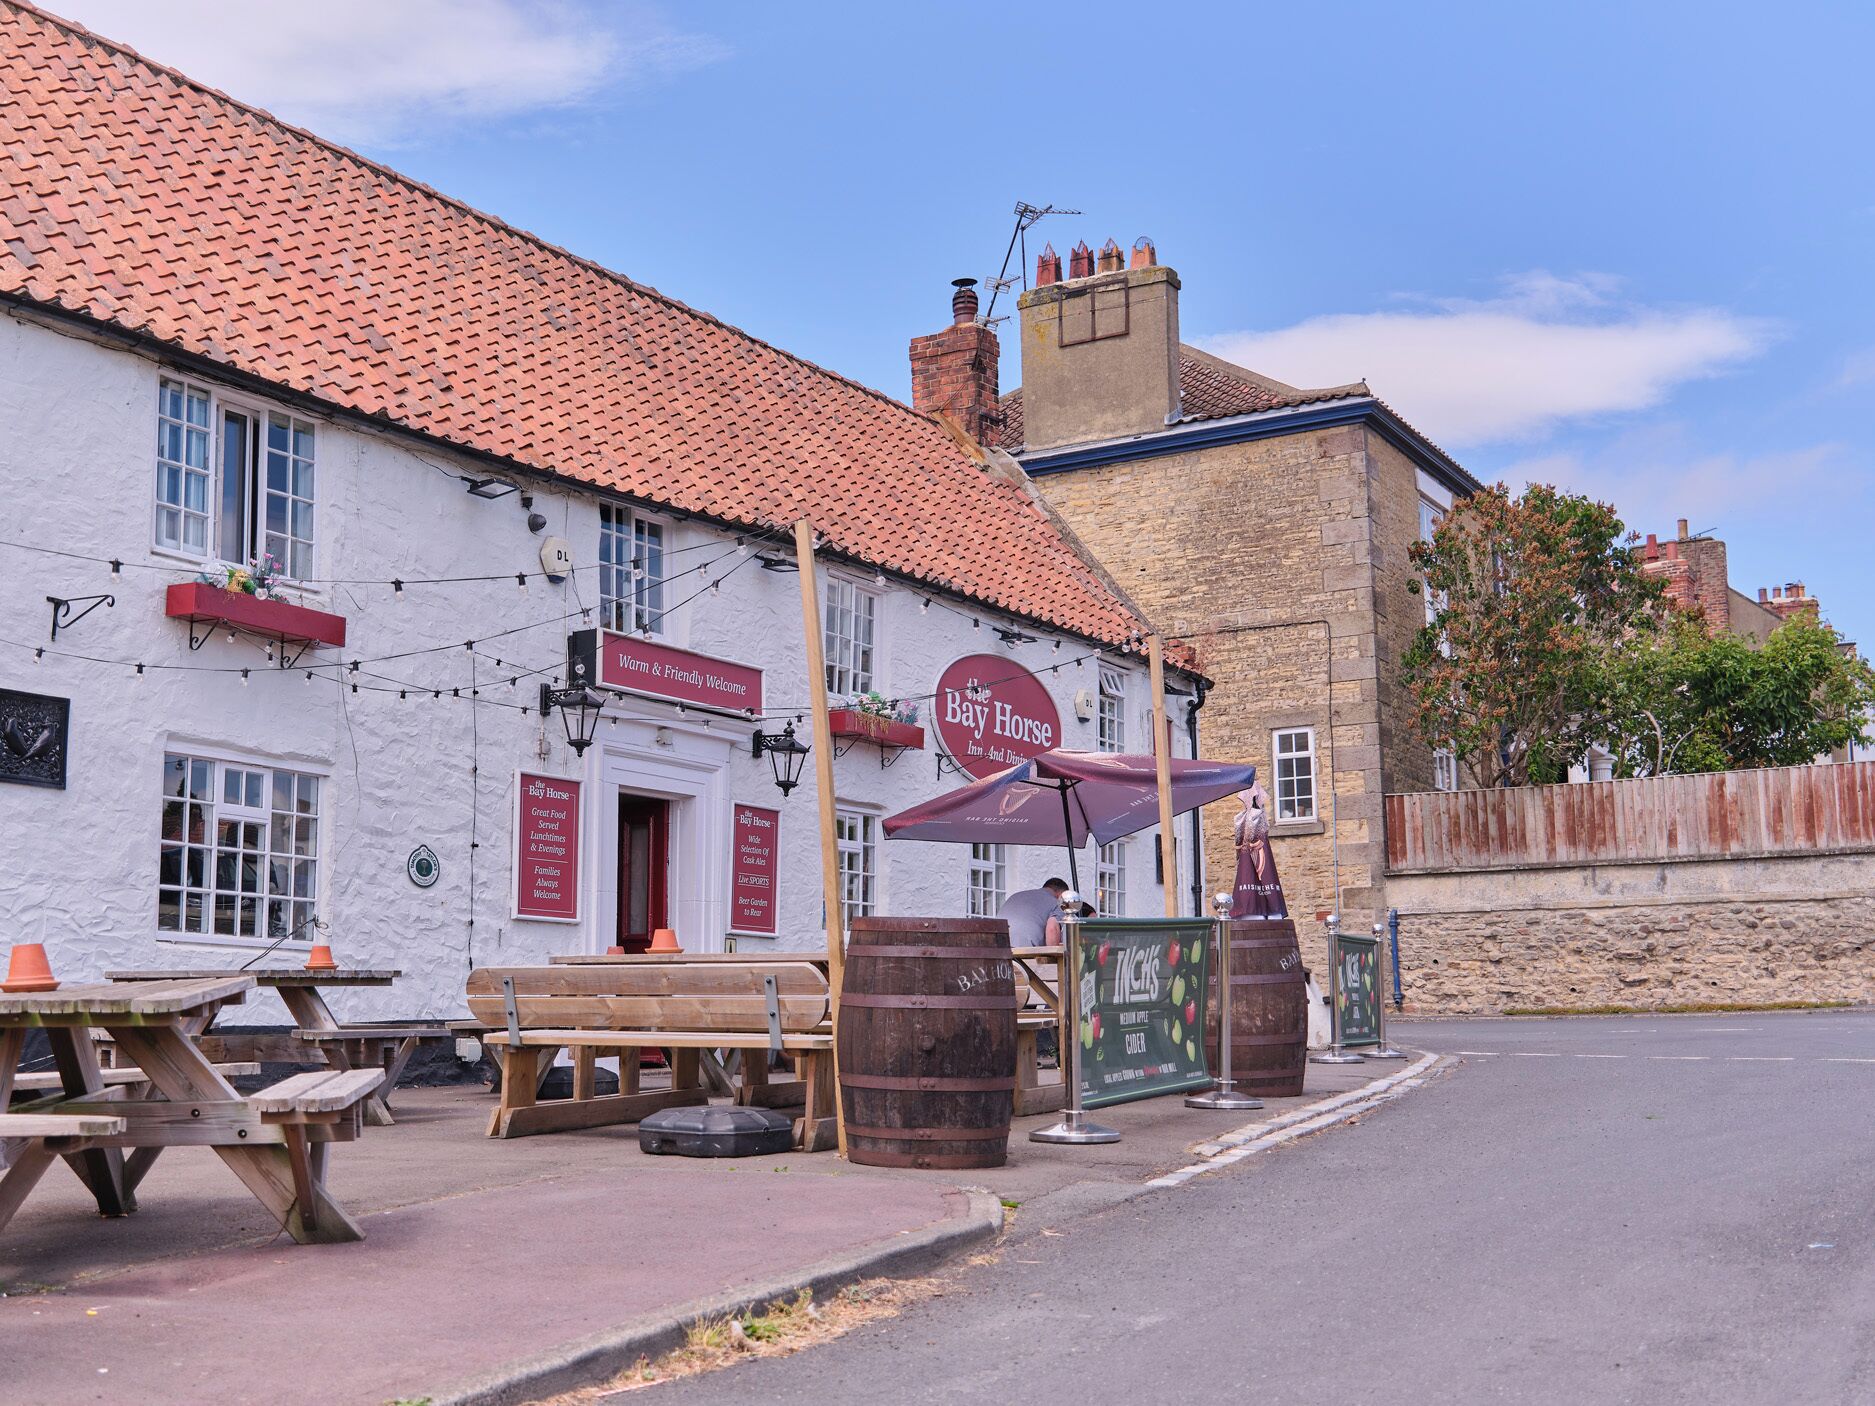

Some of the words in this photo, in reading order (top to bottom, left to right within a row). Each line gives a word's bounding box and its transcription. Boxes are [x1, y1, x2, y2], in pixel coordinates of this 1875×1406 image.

[619, 654, 649, 674] Warm
[652, 663, 662, 676] &
[665, 665, 704, 688] Friendly
[706, 674, 746, 695] Welcome
[945, 687, 989, 739] Bay
[994, 701, 1052, 747] Horse
[968, 741, 983, 756] Inn
[985, 746, 1004, 762] And
[1006, 750, 1028, 765] Dinin
[535, 780, 545, 789] the
[529, 785, 544, 798] Bay
[546, 788, 569, 800] Horse
[531, 807, 549, 818] Great
[550, 810, 566, 819] Food
[744, 810, 753, 818] the
[538, 820, 559, 830] Served
[740, 815, 753, 826] Bay
[753, 817, 771, 828] Horse
[530, 831, 566, 843] Lunchtimes
[748, 835, 761, 844] Wide
[530, 843, 537, 851] &
[538, 844, 566, 856] Evenings
[740, 845, 762, 854] Selection
[762, 848, 769, 857] Of
[743, 856, 755, 865] Cask
[755, 858, 766, 866] Ales
[534, 866, 561, 876] Families
[536, 878, 558, 889] Always
[738, 875, 749, 884] Live
[749, 877, 769, 886] SPORTS
[533, 890, 561, 900] Welcome
[738, 897, 750, 905] Beer
[751, 898, 768, 907] Garden
[744, 908, 750, 916] to
[750, 909, 762, 917] Rear
[1120, 1012, 1136, 1025] MEDIUM
[1137, 1010, 1149, 1024] APPLE
[1126, 1032, 1146, 1055] CIDER
